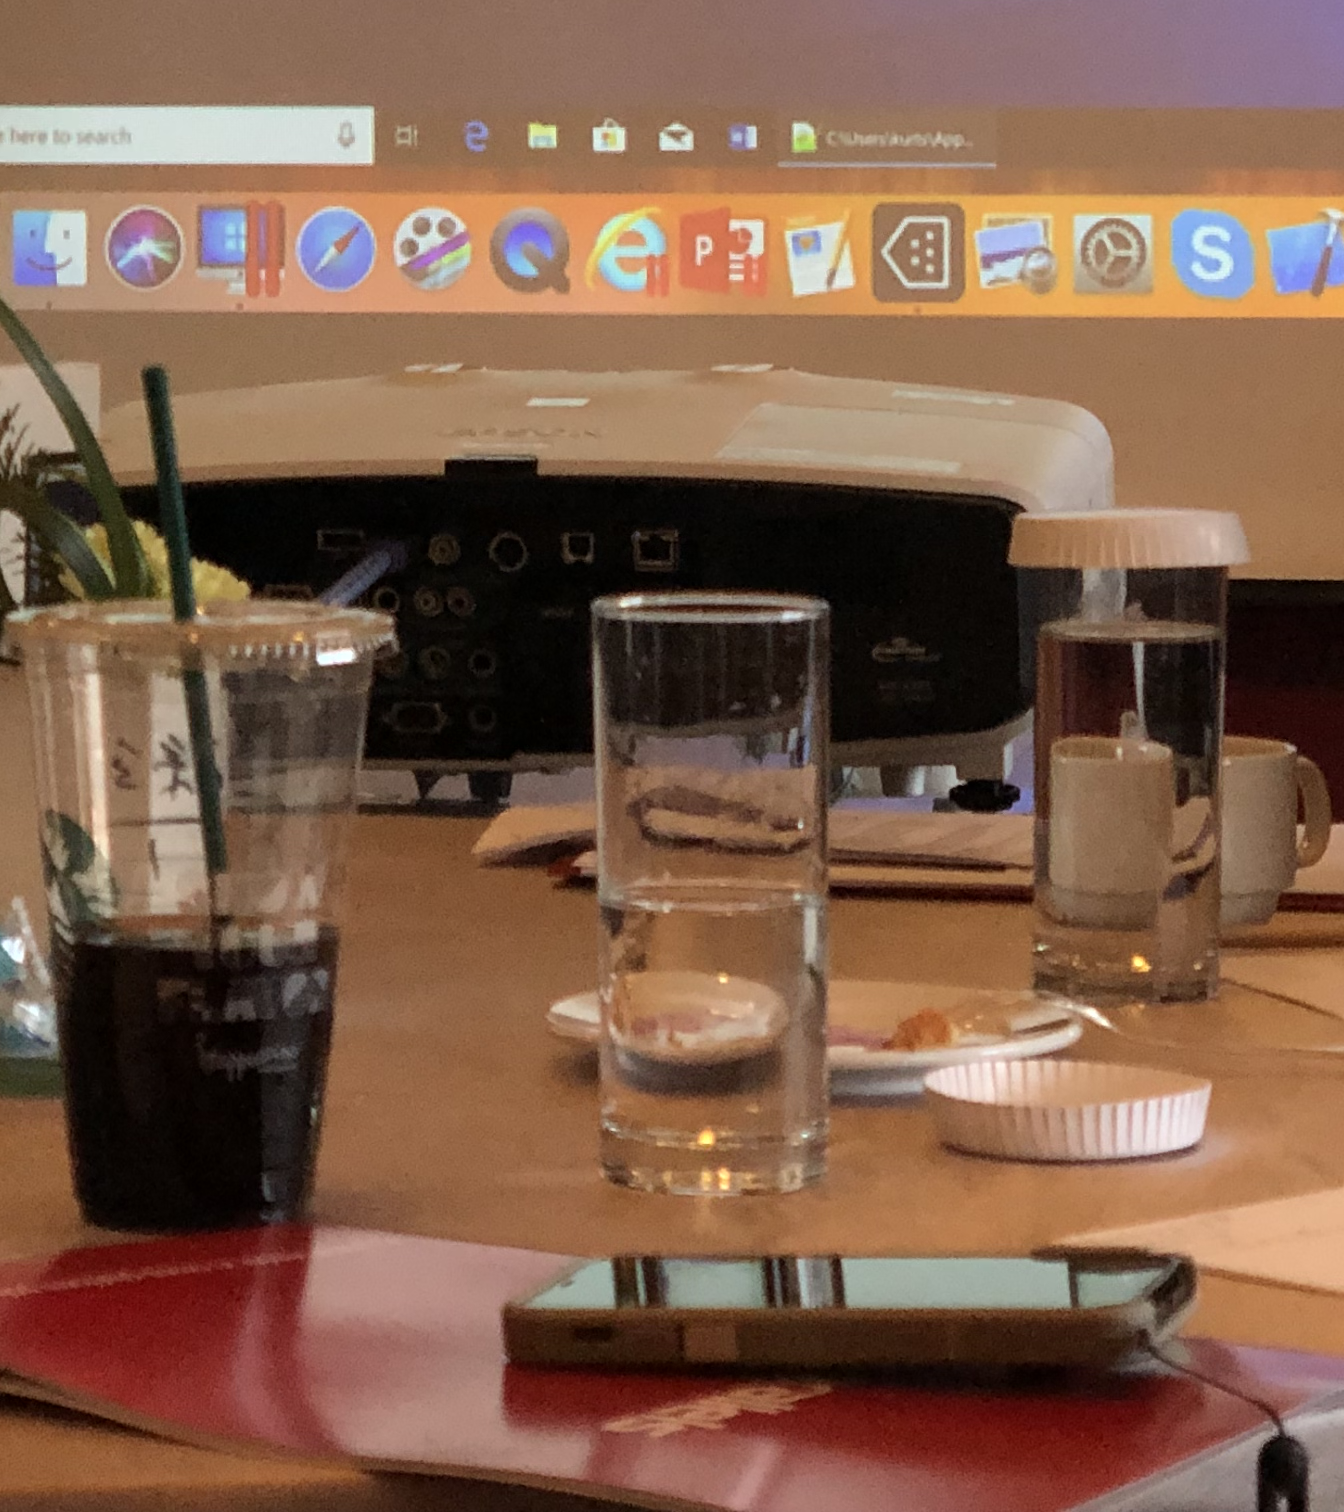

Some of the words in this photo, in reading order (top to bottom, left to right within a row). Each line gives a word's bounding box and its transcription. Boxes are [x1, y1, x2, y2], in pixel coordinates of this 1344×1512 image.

[9, 124, 47, 146] here
[52, 125, 71, 146] to
[76, 124, 132, 146] search
